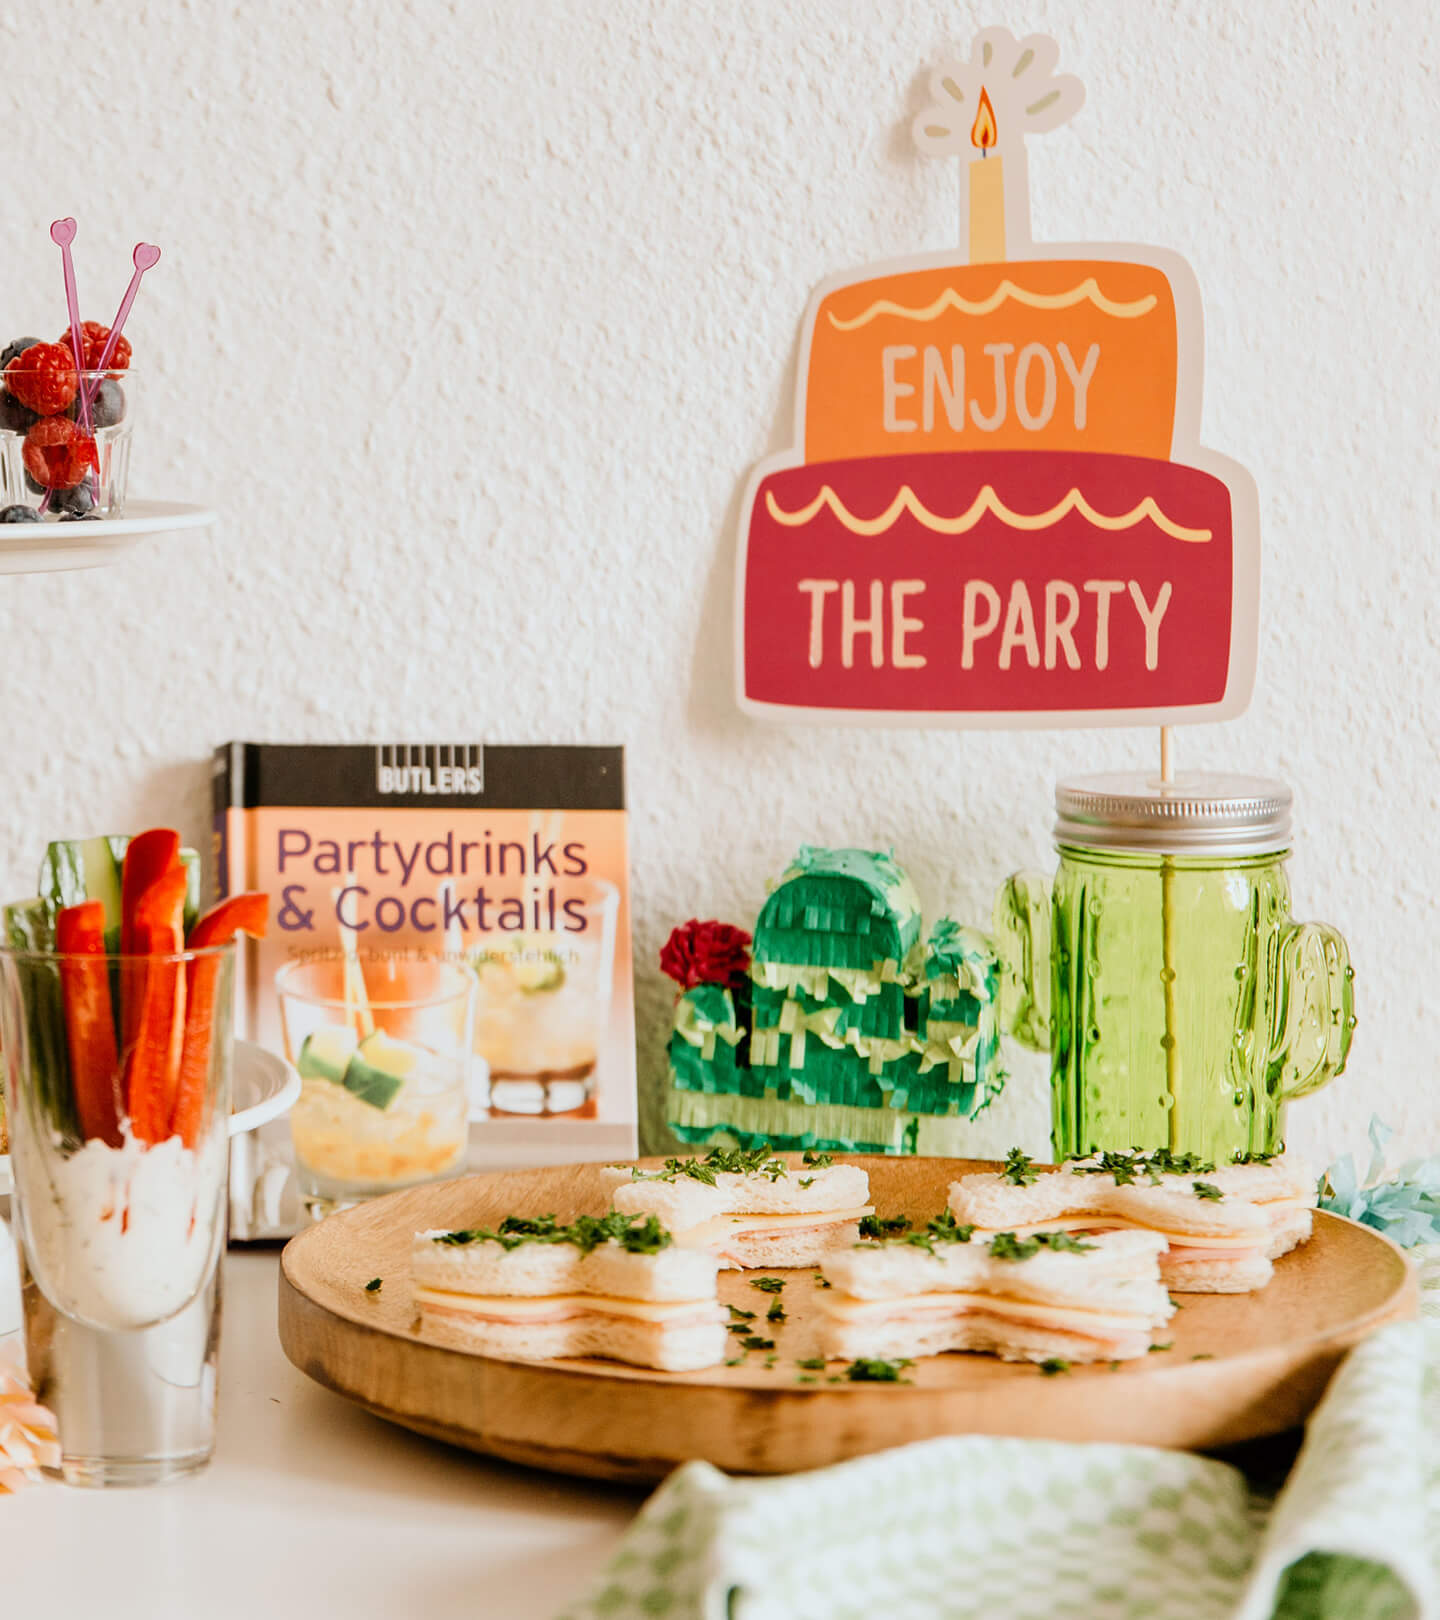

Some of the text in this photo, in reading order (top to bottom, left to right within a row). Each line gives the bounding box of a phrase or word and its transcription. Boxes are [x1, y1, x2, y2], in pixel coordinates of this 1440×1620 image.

[881, 341, 1100, 432] ENJOY
[798, 579, 1172, 671] THE PARTY
[377, 764, 483, 794] BUTLERS
[277, 830, 588, 887] Partydrinks
[277, 885, 588, 932] & Cocktails
